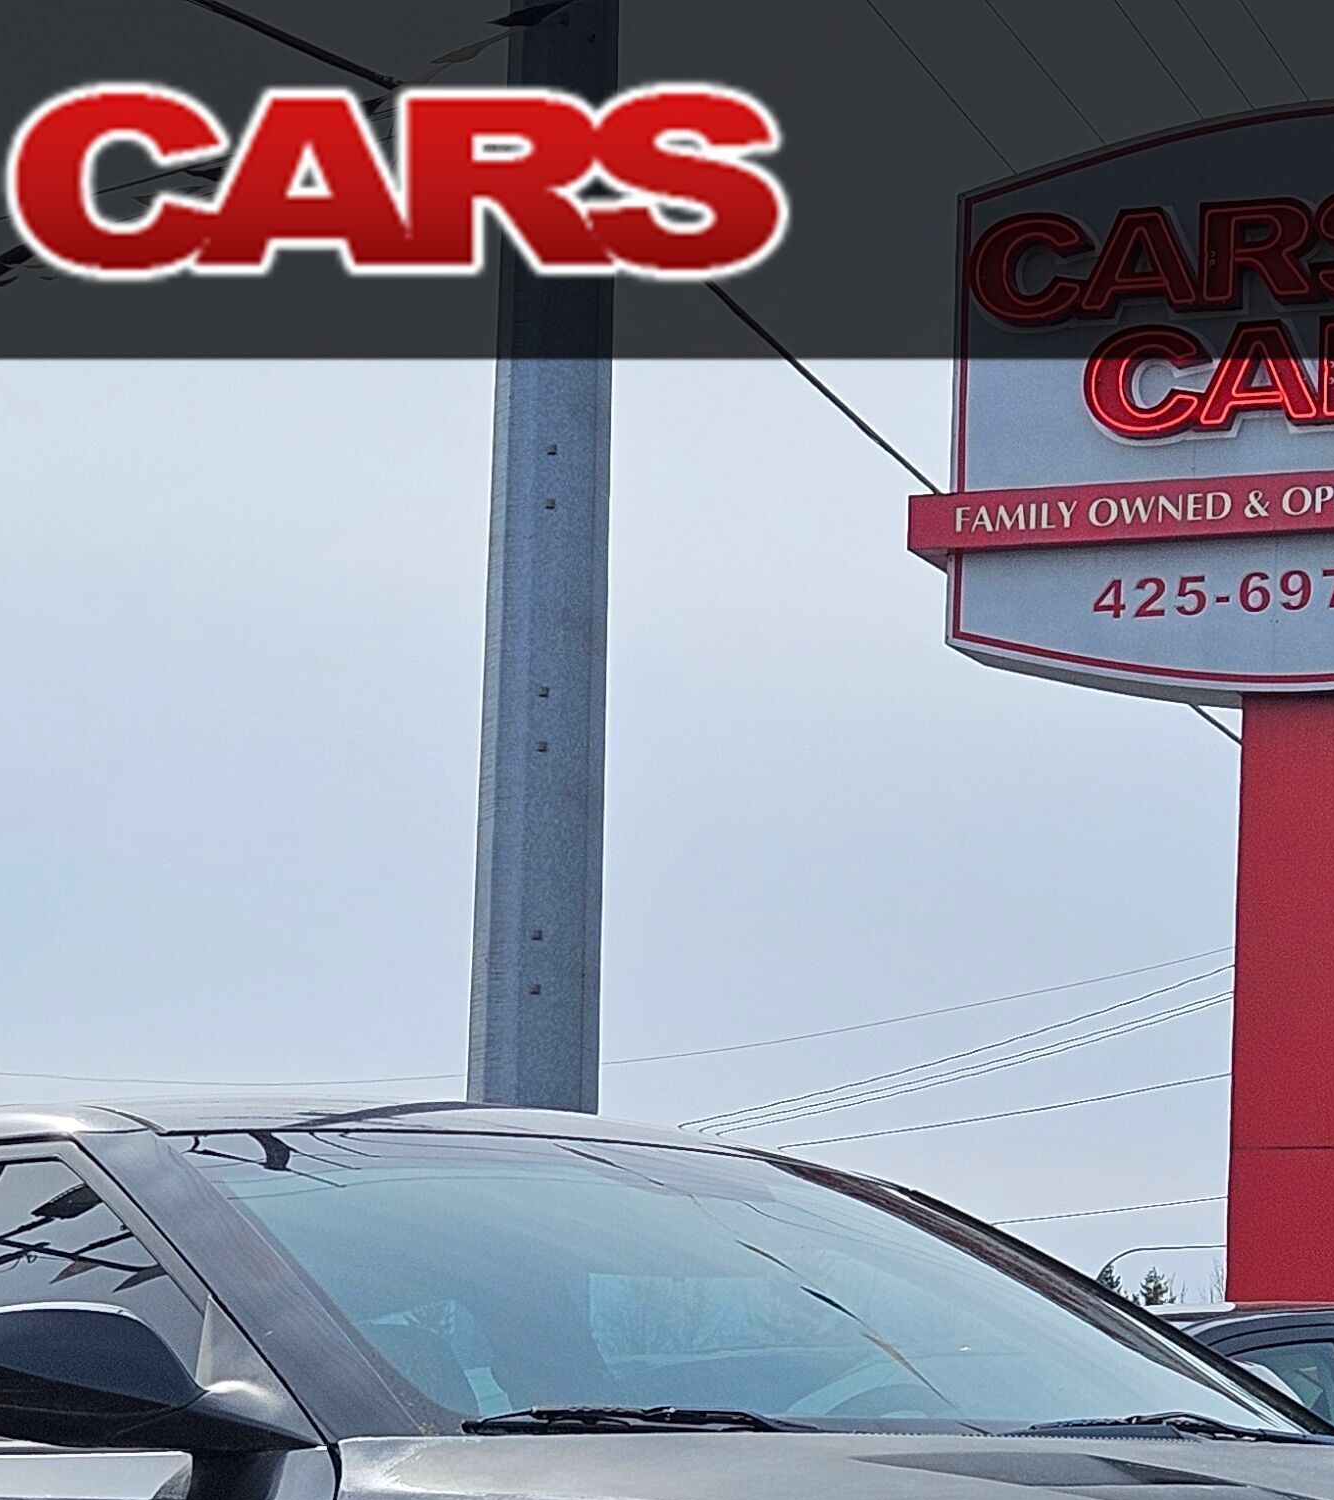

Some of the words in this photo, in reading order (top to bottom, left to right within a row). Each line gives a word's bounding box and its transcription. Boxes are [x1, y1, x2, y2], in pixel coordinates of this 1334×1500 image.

[954, 500, 1078, 534] FAMILY
[1087, 490, 1233, 528] OWNED
[1243, 489, 1270, 520] &
